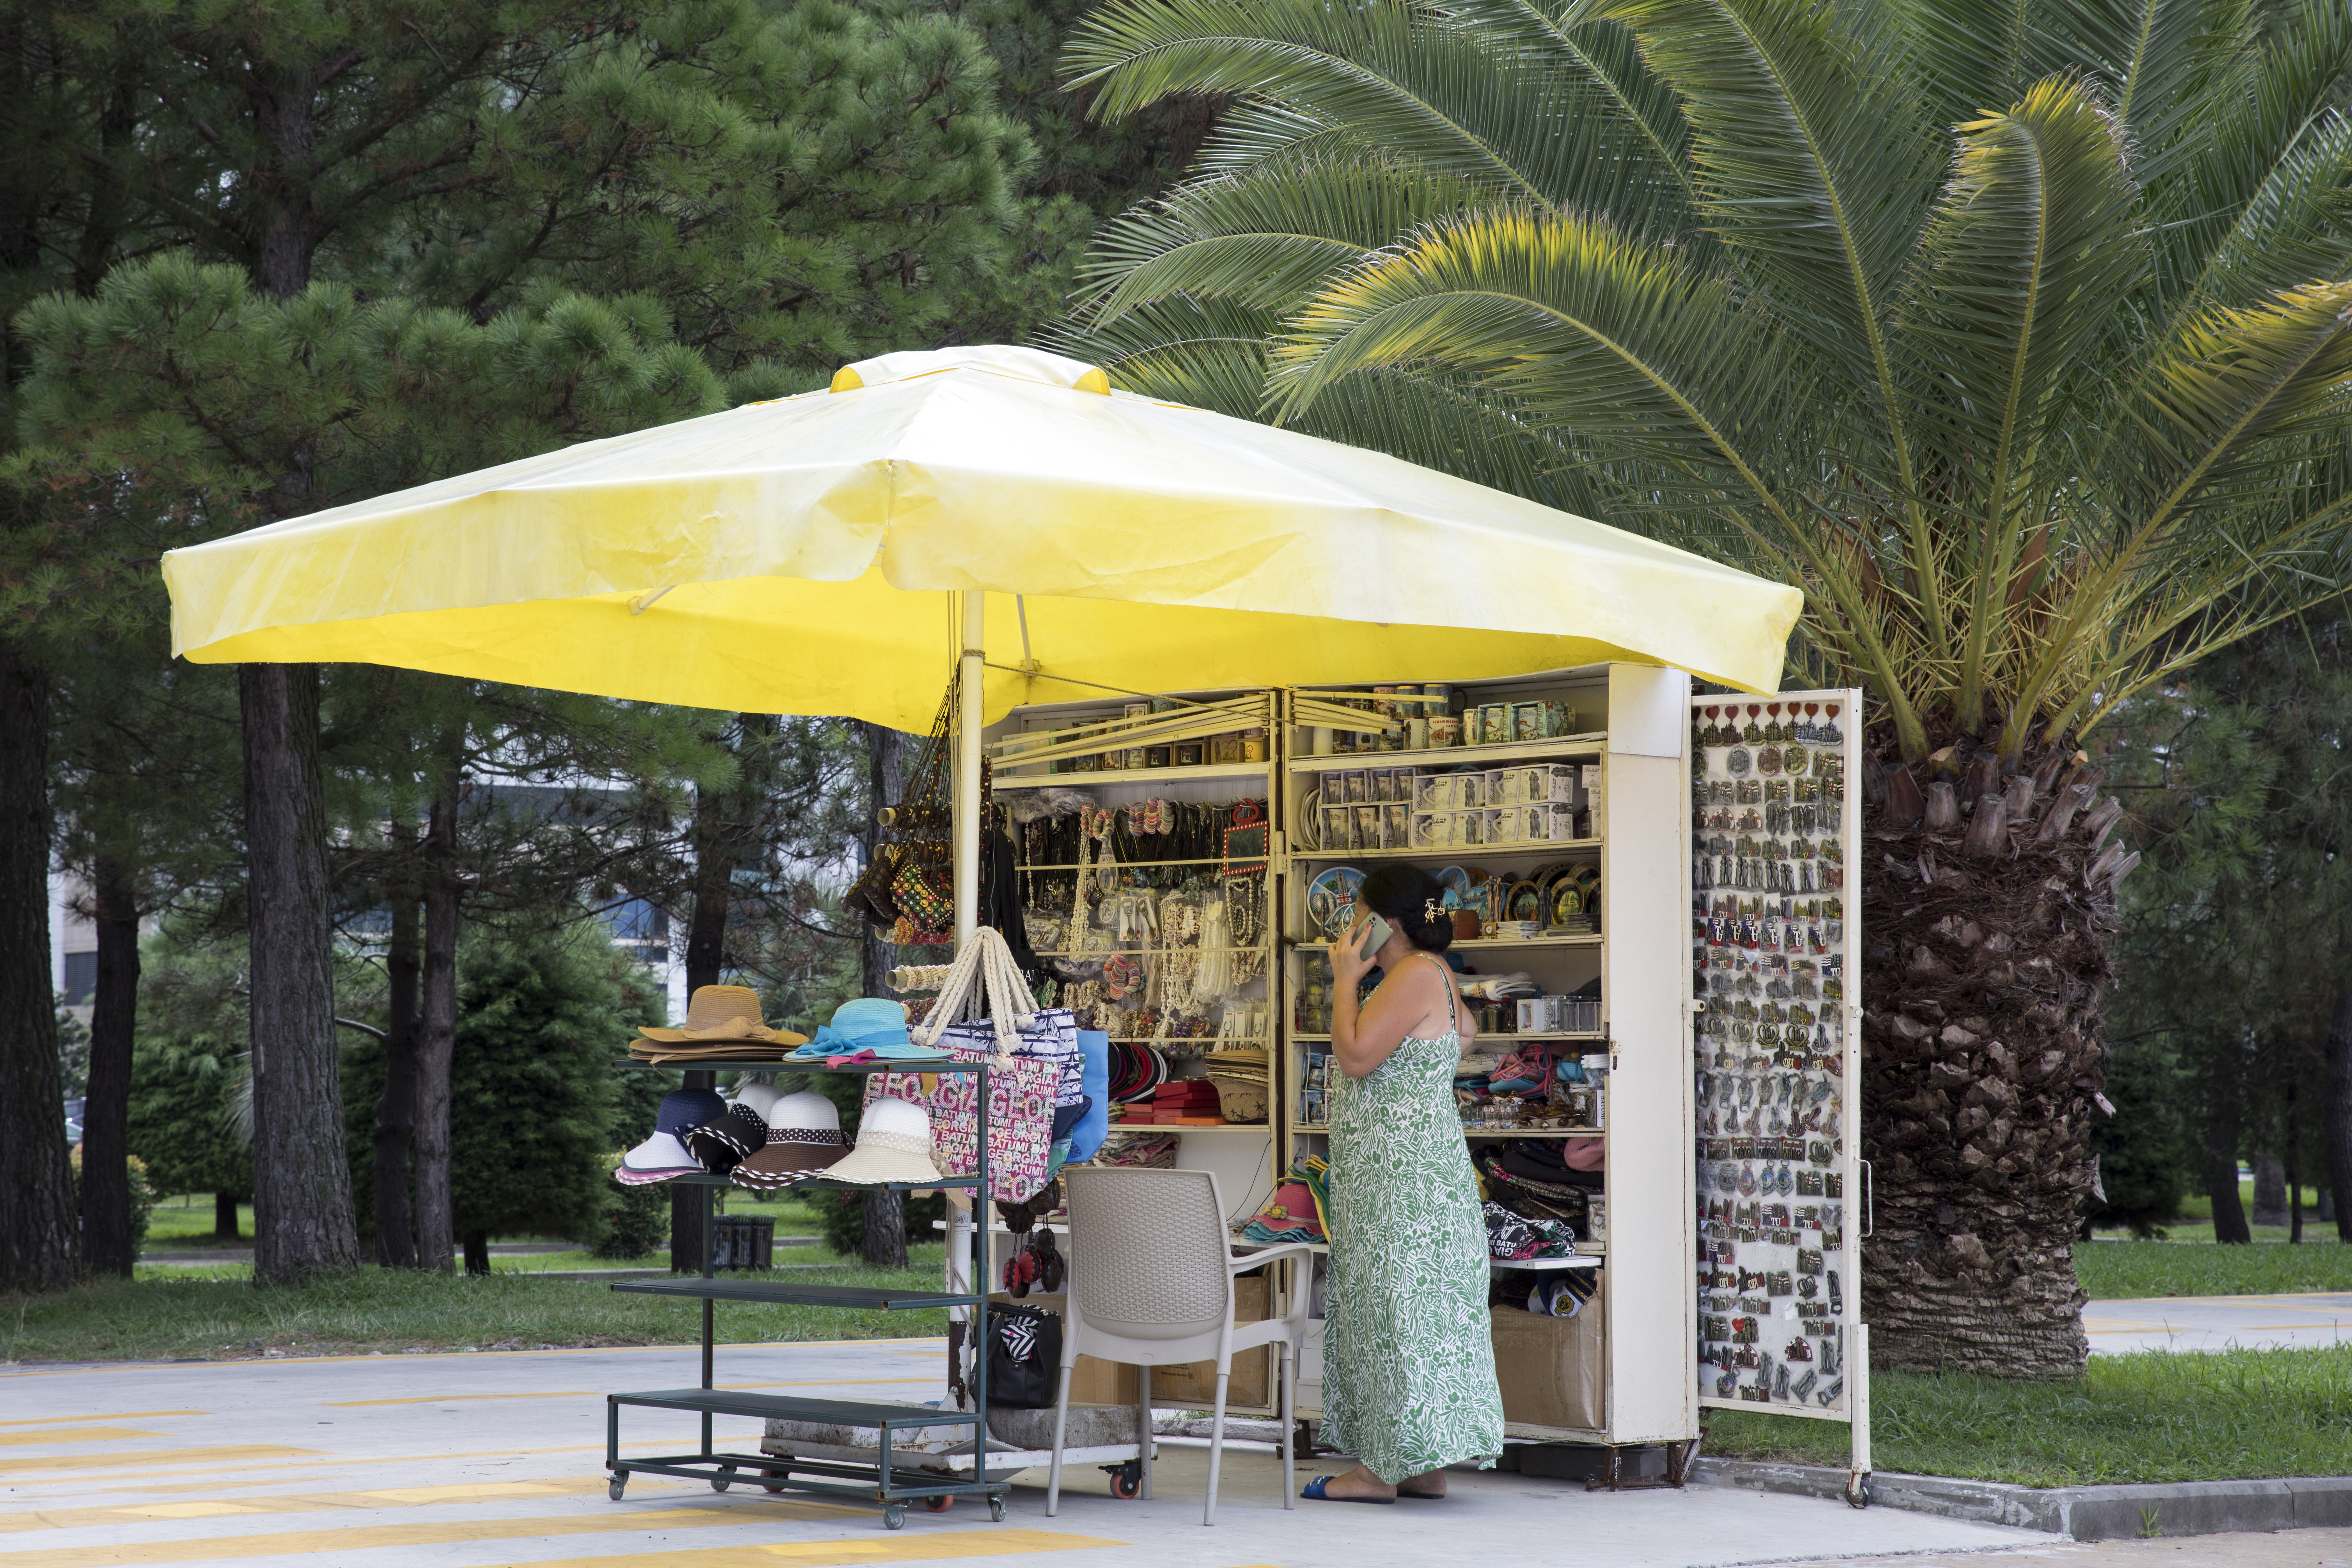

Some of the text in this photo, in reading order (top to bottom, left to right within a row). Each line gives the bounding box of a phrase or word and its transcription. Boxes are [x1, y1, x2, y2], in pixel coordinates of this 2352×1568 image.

[1019, 1083, 1055, 1096] BATUMI
[935, 1108, 972, 1122] BATUMI
[1014, 1120, 1051, 1134] BATUMI
[995, 1127, 1049, 1145] GEORGIA
[988, 1136, 1028, 1152] BATUMI
[988, 1148, 1042, 1166] GEORGIA
[1005, 1162, 1043, 1176] BATUMI
